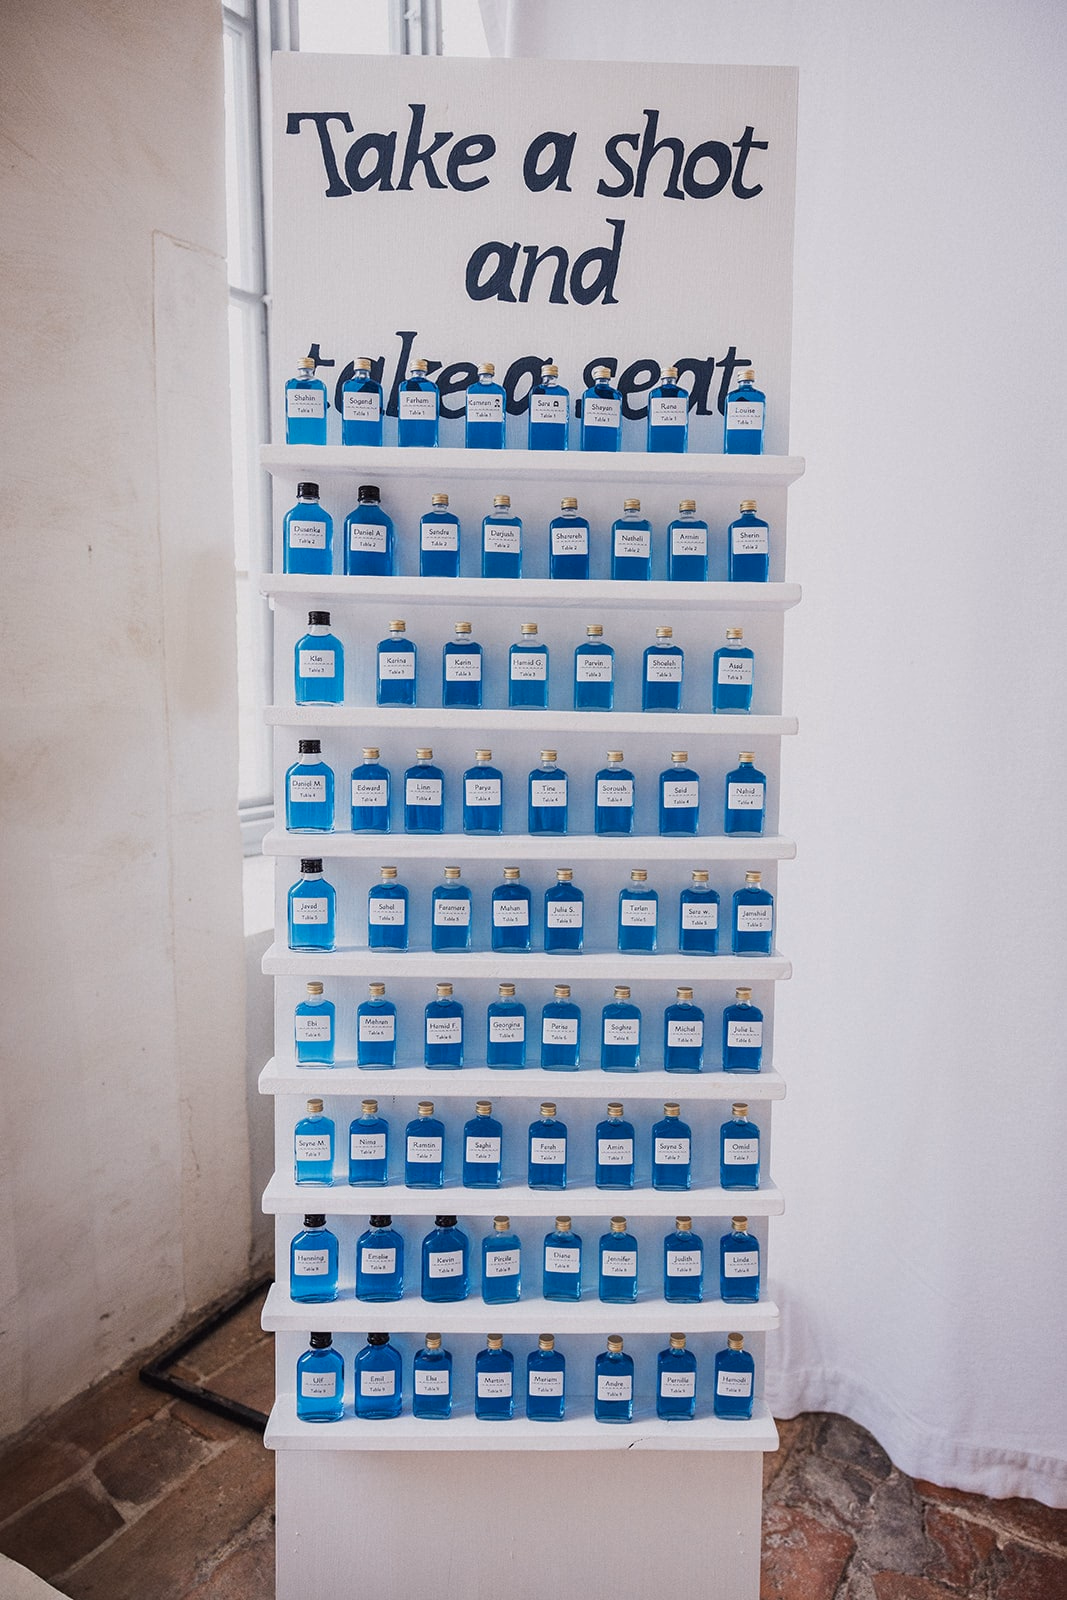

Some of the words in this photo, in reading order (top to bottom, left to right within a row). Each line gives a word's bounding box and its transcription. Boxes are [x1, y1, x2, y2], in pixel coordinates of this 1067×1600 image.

[286, 104, 496, 197] Take
[523, 131, 577, 192] a
[597, 109, 769, 200] shot
[465, 218, 625, 305] and
[503, 355, 553, 416] a
[298, 1254, 324, 1262] Henning
[437, 1256, 455, 1264] Kevin
[674, 1255, 693, 1263] Judith
